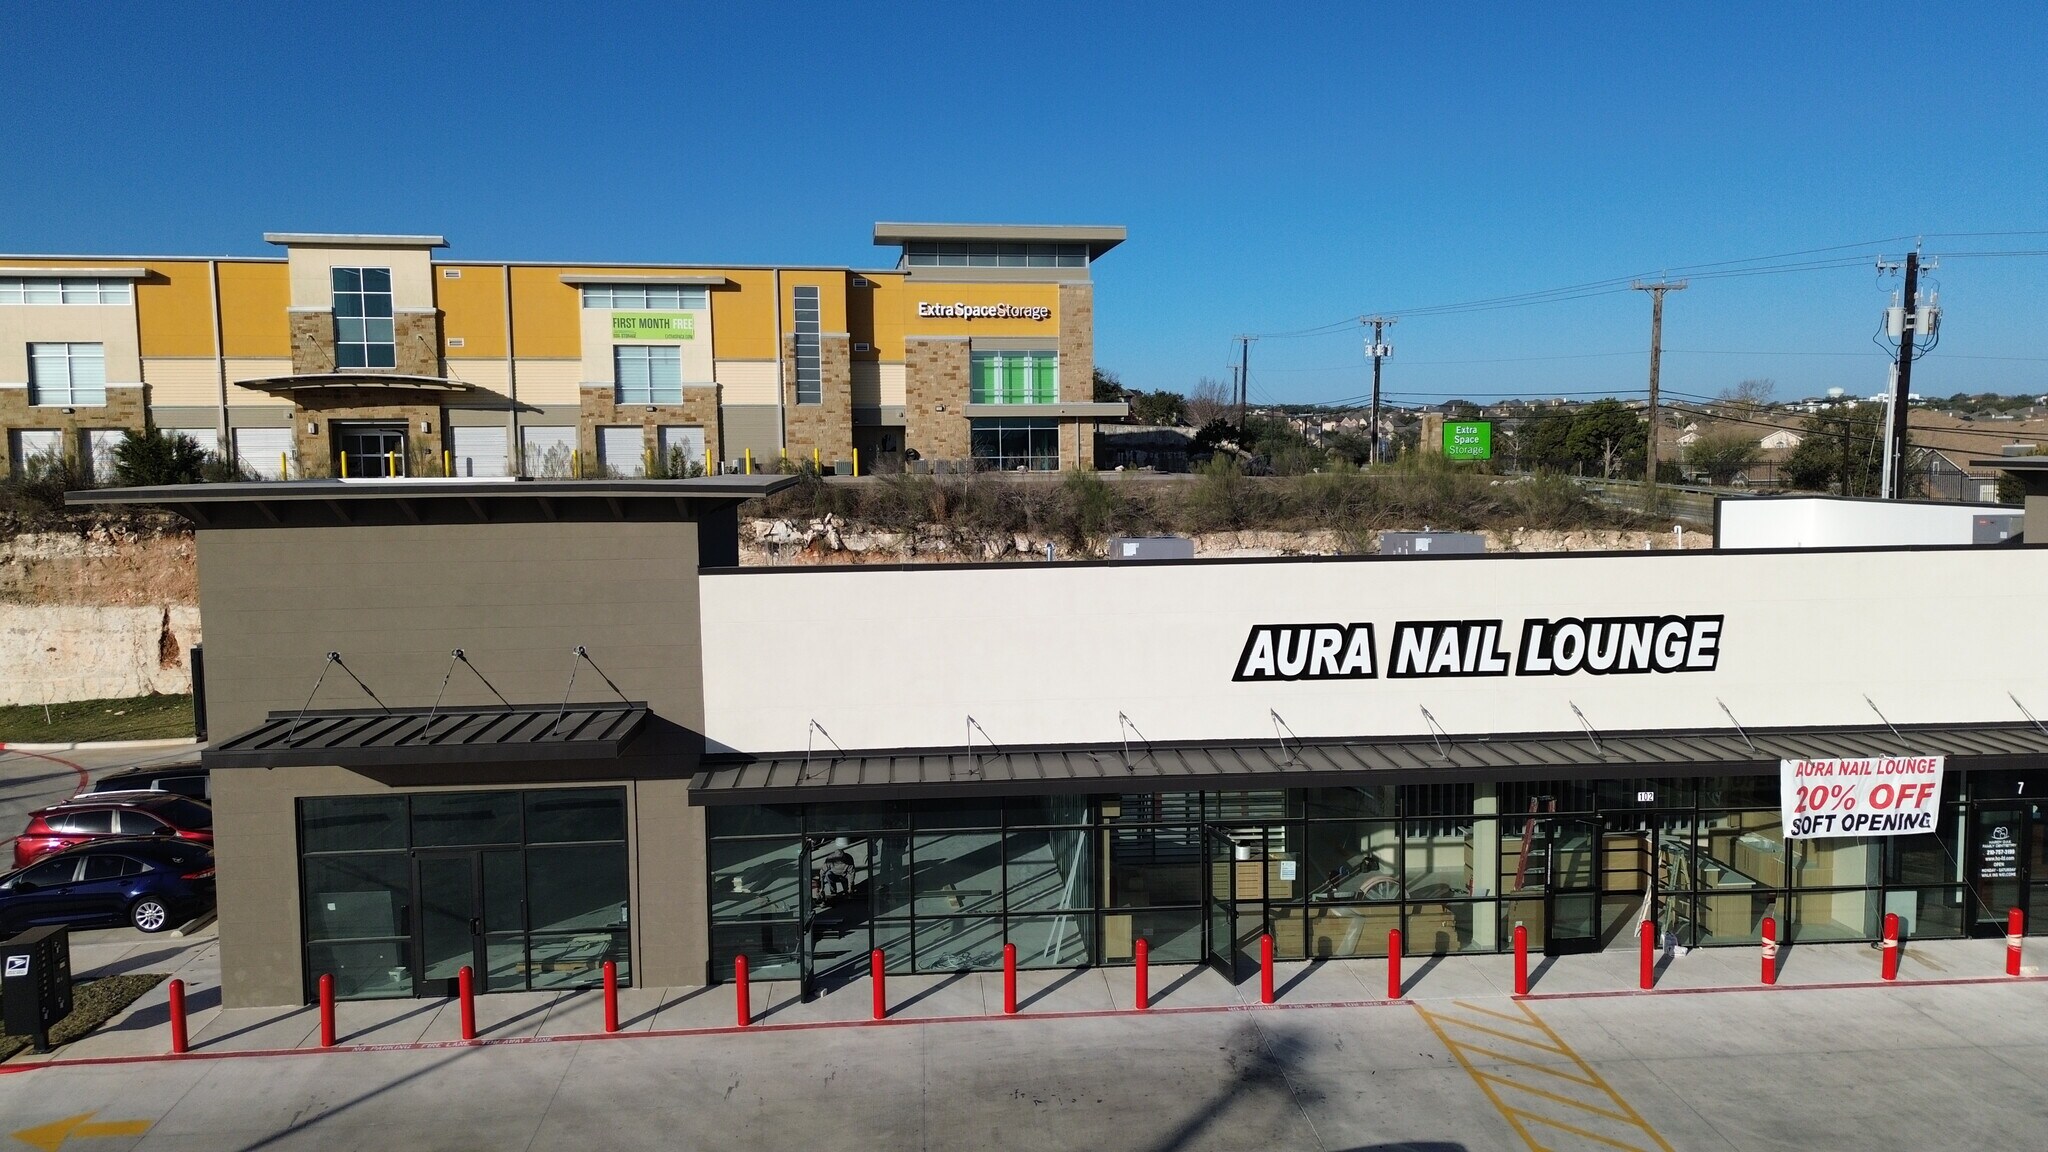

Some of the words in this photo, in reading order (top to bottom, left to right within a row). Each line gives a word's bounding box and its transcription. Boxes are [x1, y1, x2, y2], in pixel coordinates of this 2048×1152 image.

[612, 317, 637, 329] FIRST
[638, 318, 670, 329] MONTH
[672, 318, 693, 330] FREE
[1456, 426, 1478, 434] Extra
[1454, 435, 1479, 445] Space
[1449, 445, 1484, 456] Storage
[1237, 625, 1376, 679] AURA
[1391, 622, 1508, 676] NAIL
[1520, 618, 1722, 674] LOUNGE
[1795, 761, 1834, 777] AURA
[1838, 760, 1872, 776] NAIL
[1876, 758, 1937, 775] LOUNGE
[2017, 781, 2025, 795] 7
[1639, 792, 1653, 801] 102
[1794, 784, 1857, 814] 20%
[1868, 782, 1936, 811] OFF
[1791, 814, 1837, 836] SOFT
[1841, 812, 1932, 832] OPENING
